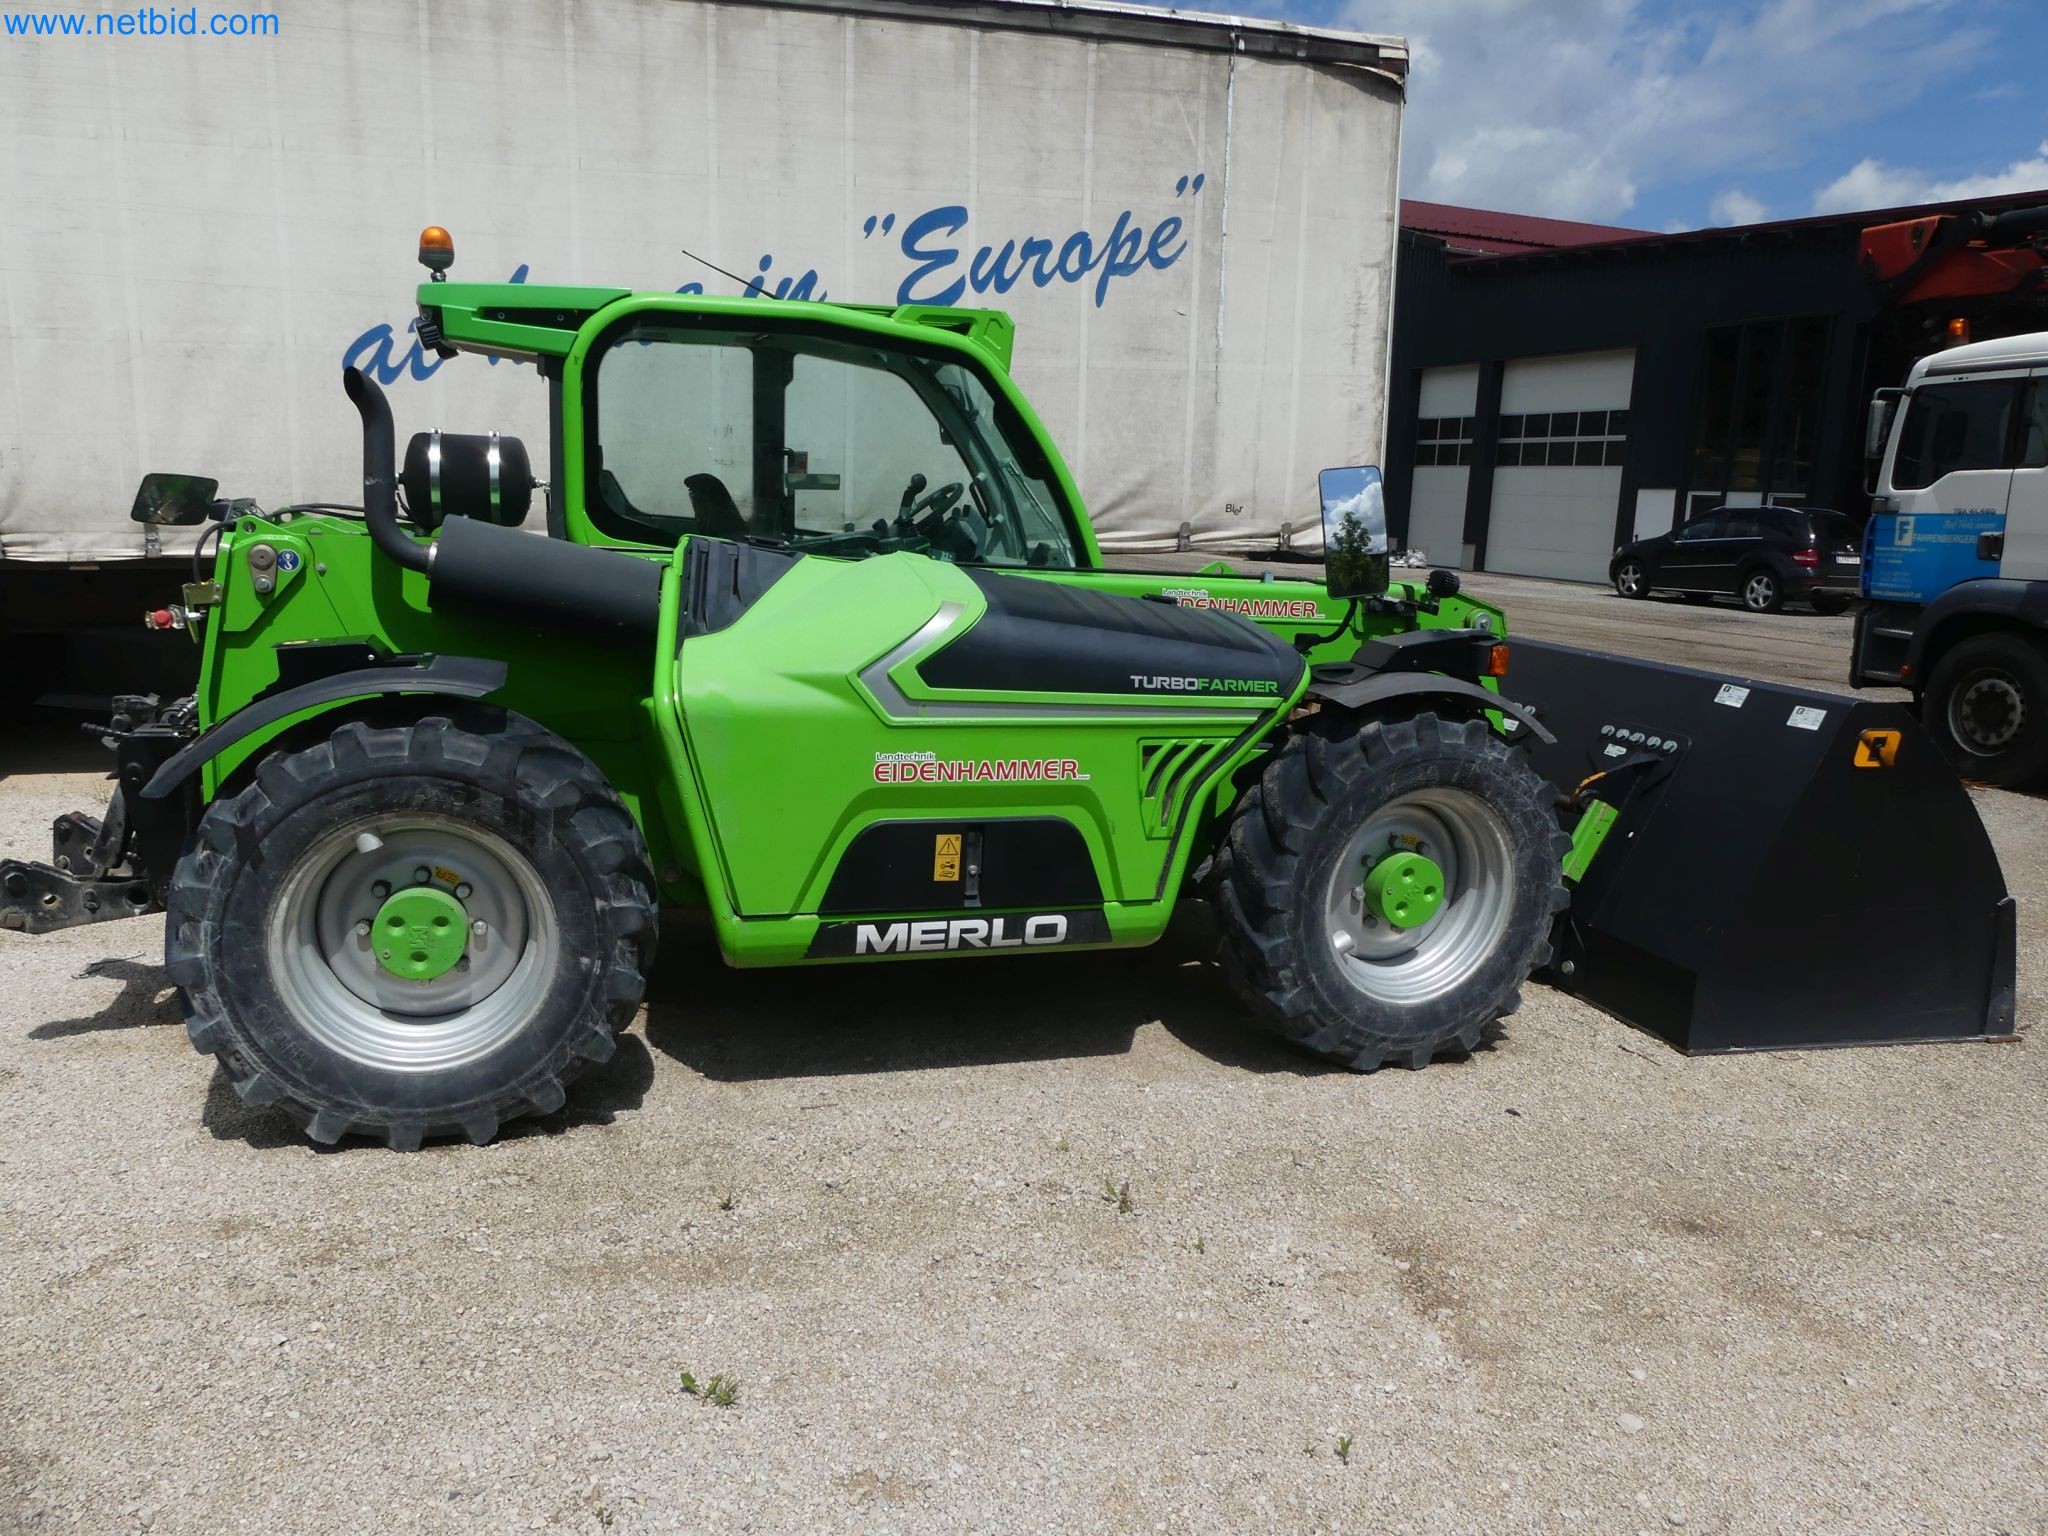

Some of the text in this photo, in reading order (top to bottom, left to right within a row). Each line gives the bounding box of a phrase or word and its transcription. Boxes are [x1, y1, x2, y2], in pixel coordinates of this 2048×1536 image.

[1913, 533, 1976, 544] FAHRENBERGER
[1162, 588, 1209, 598] Landtechnik
[1176, 597, 1317, 618] DENHAMMER
[1130, 675, 1278, 693] TURBOFARMER
[876, 752, 936, 761] Landtechnik
[873, 759, 1079, 783] EIDENHAMMER
[855, 914, 1068, 954] MERLO
